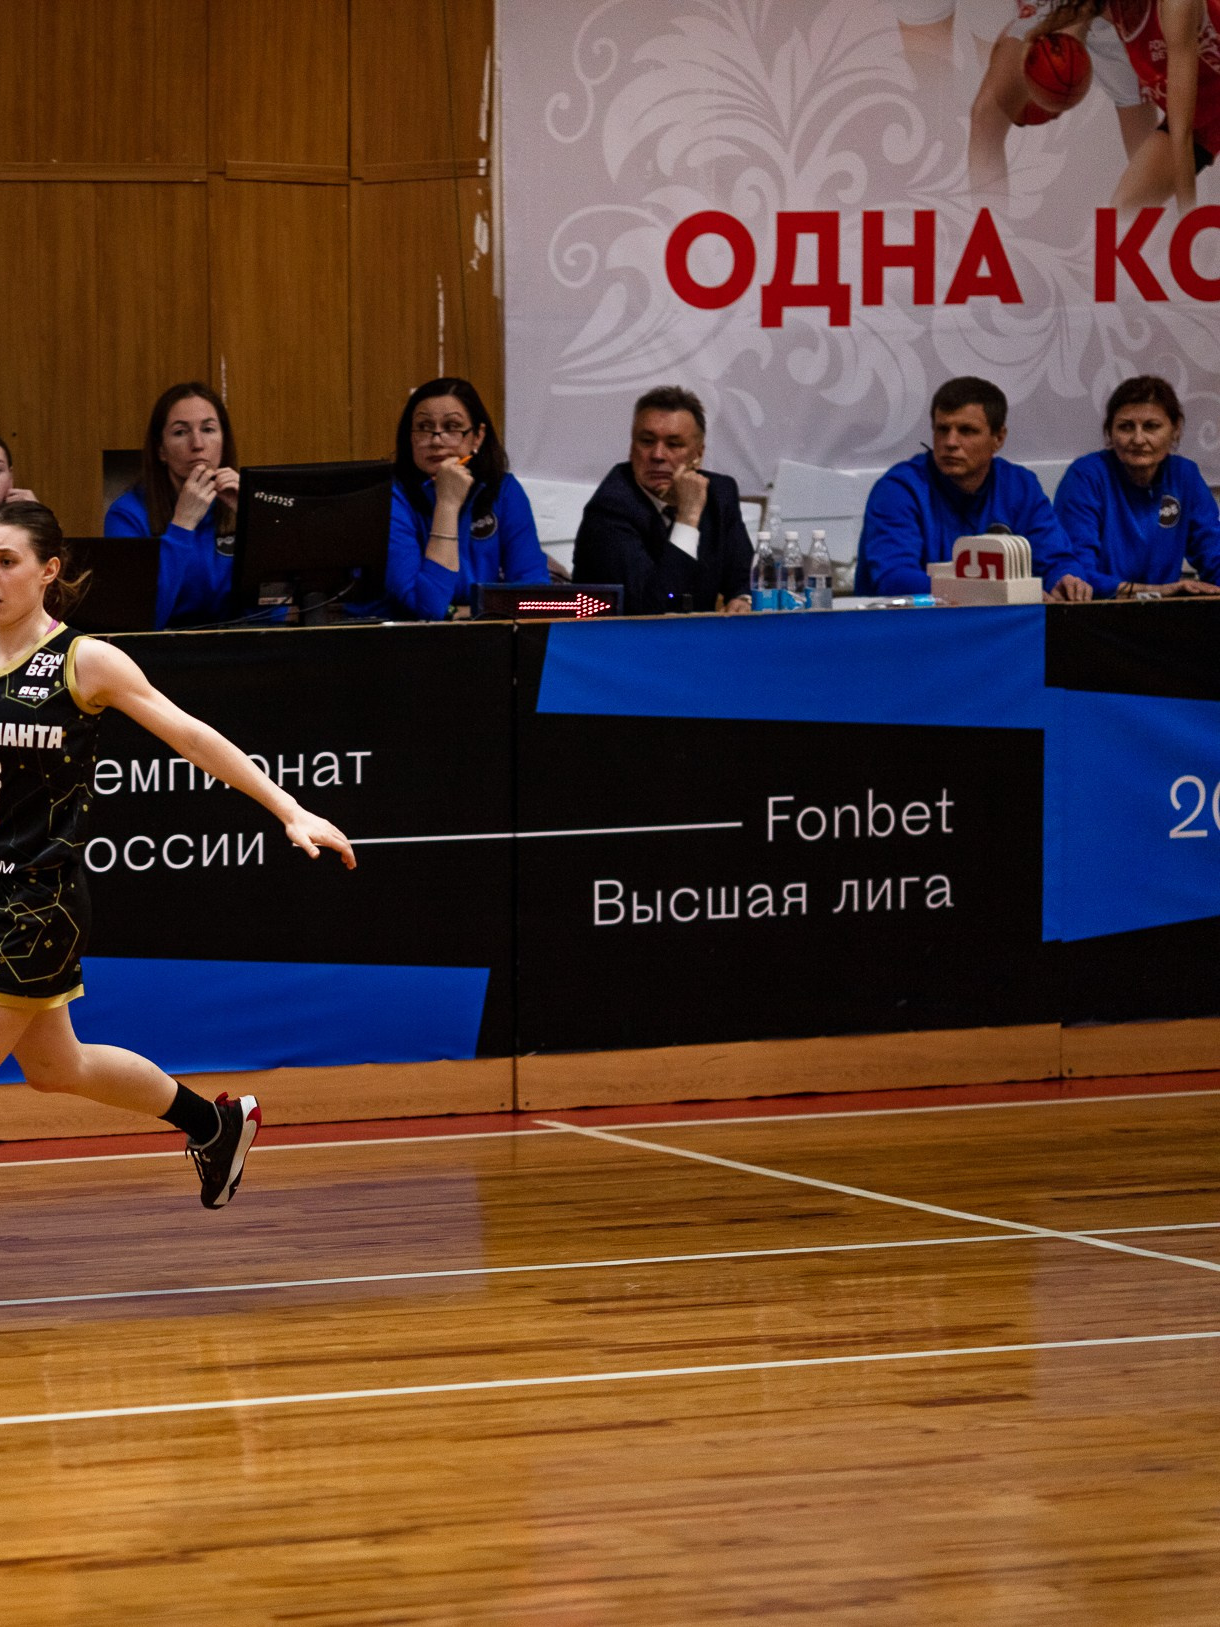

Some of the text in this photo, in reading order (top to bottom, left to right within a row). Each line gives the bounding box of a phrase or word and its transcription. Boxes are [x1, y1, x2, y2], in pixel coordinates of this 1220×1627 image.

[665, 207, 1024, 328] ОДНА
[25, 664, 59, 677] BET
[31, 652, 65, 666] FON
[767, 788, 954, 842] Fonbet
[1169, 775, 1220, 839] 2
[83, 831, 264, 873] оссии
[593, 874, 953, 926] Высшая лига
